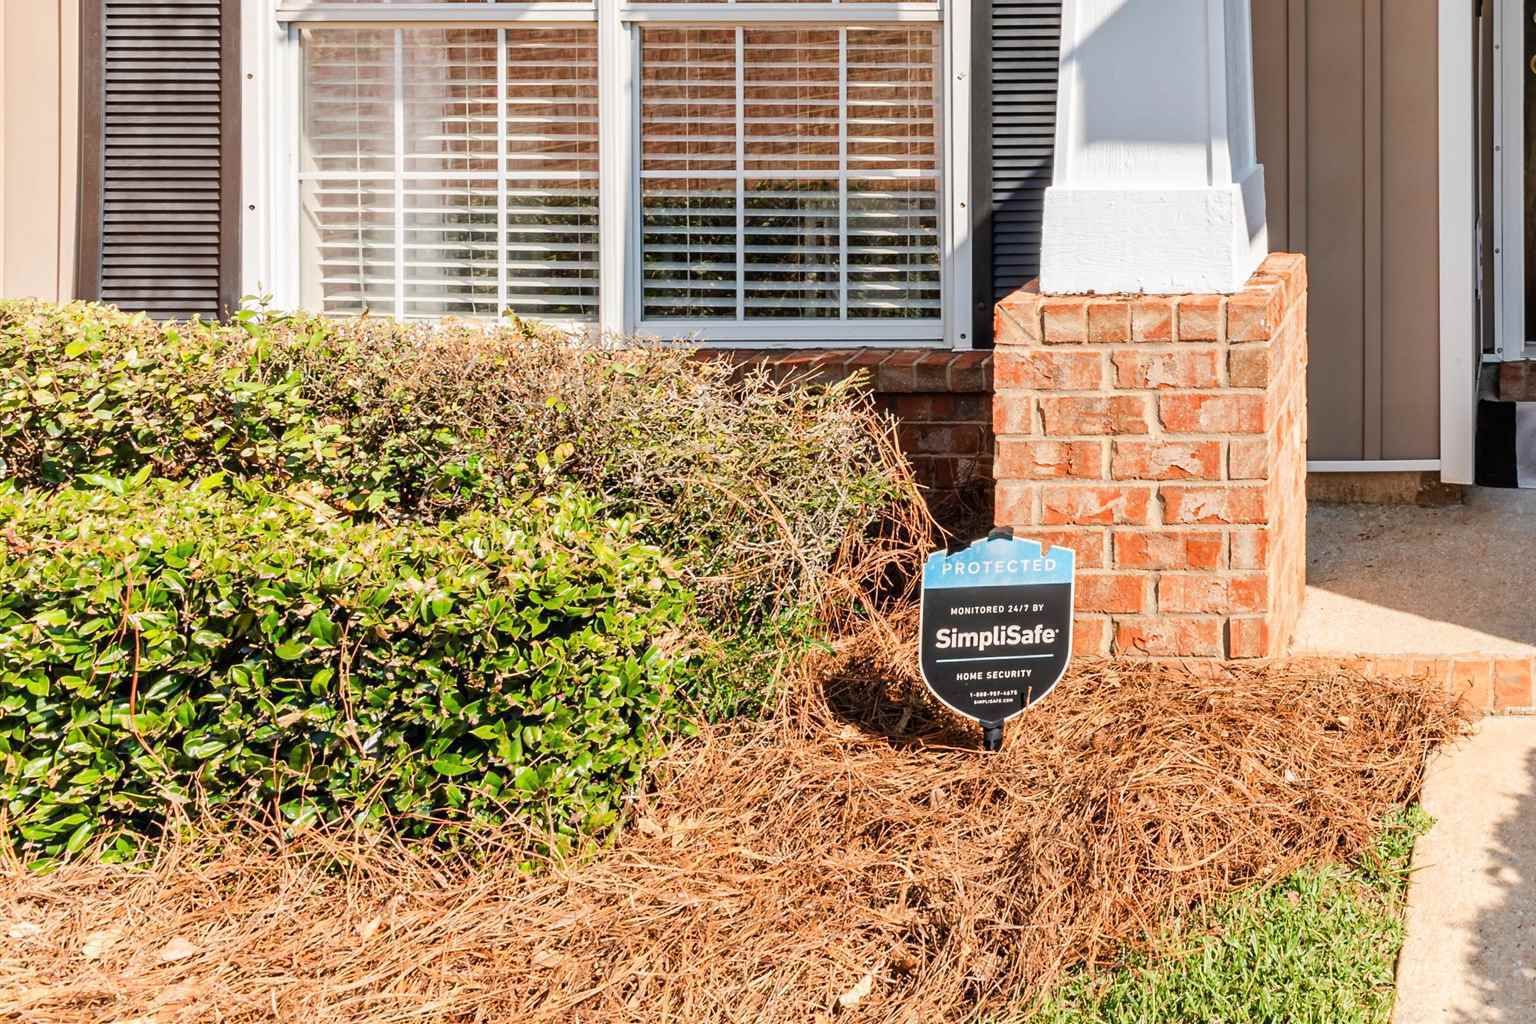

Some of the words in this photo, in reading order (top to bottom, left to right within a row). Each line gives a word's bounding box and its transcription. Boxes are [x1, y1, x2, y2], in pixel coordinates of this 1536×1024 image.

[942, 558, 1057, 576] PROTECTED
[950, 605, 1005, 616] MONITORED
[1007, 604, 1030, 613] 24/7
[1032, 603, 1045, 612] BY
[935, 624, 1057, 651] SimpliSafe
[956, 672, 983, 681] HOME
[986, 669, 1032, 679] SECURITY
